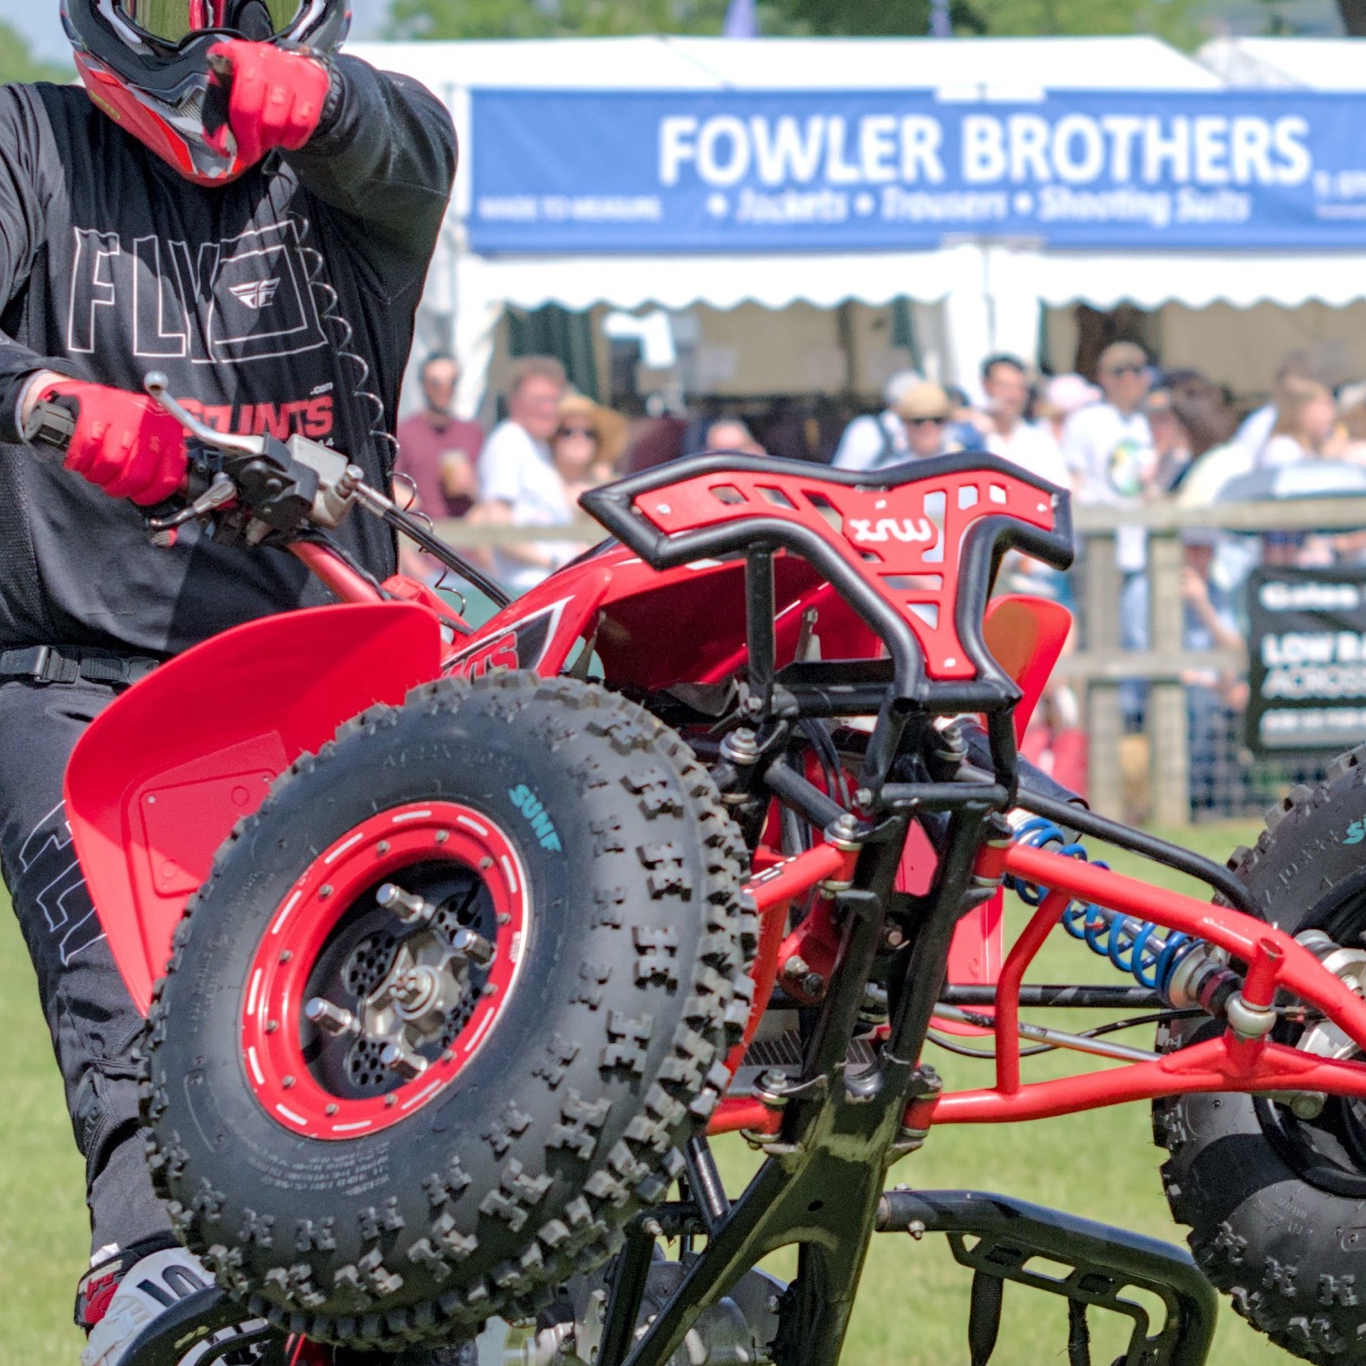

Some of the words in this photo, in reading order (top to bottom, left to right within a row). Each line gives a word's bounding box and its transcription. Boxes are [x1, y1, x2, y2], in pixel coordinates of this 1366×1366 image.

[659, 113, 944, 186] FOWLER
[962, 113, 1312, 184] BROTHERS
[1039, 188, 1170, 230] Shooting
[1177, 189, 1250, 224] Suits
[309, 382, 333, 395] .com
[1262, 633, 1334, 666] LOW
[509, 784, 562, 852] SUNF
